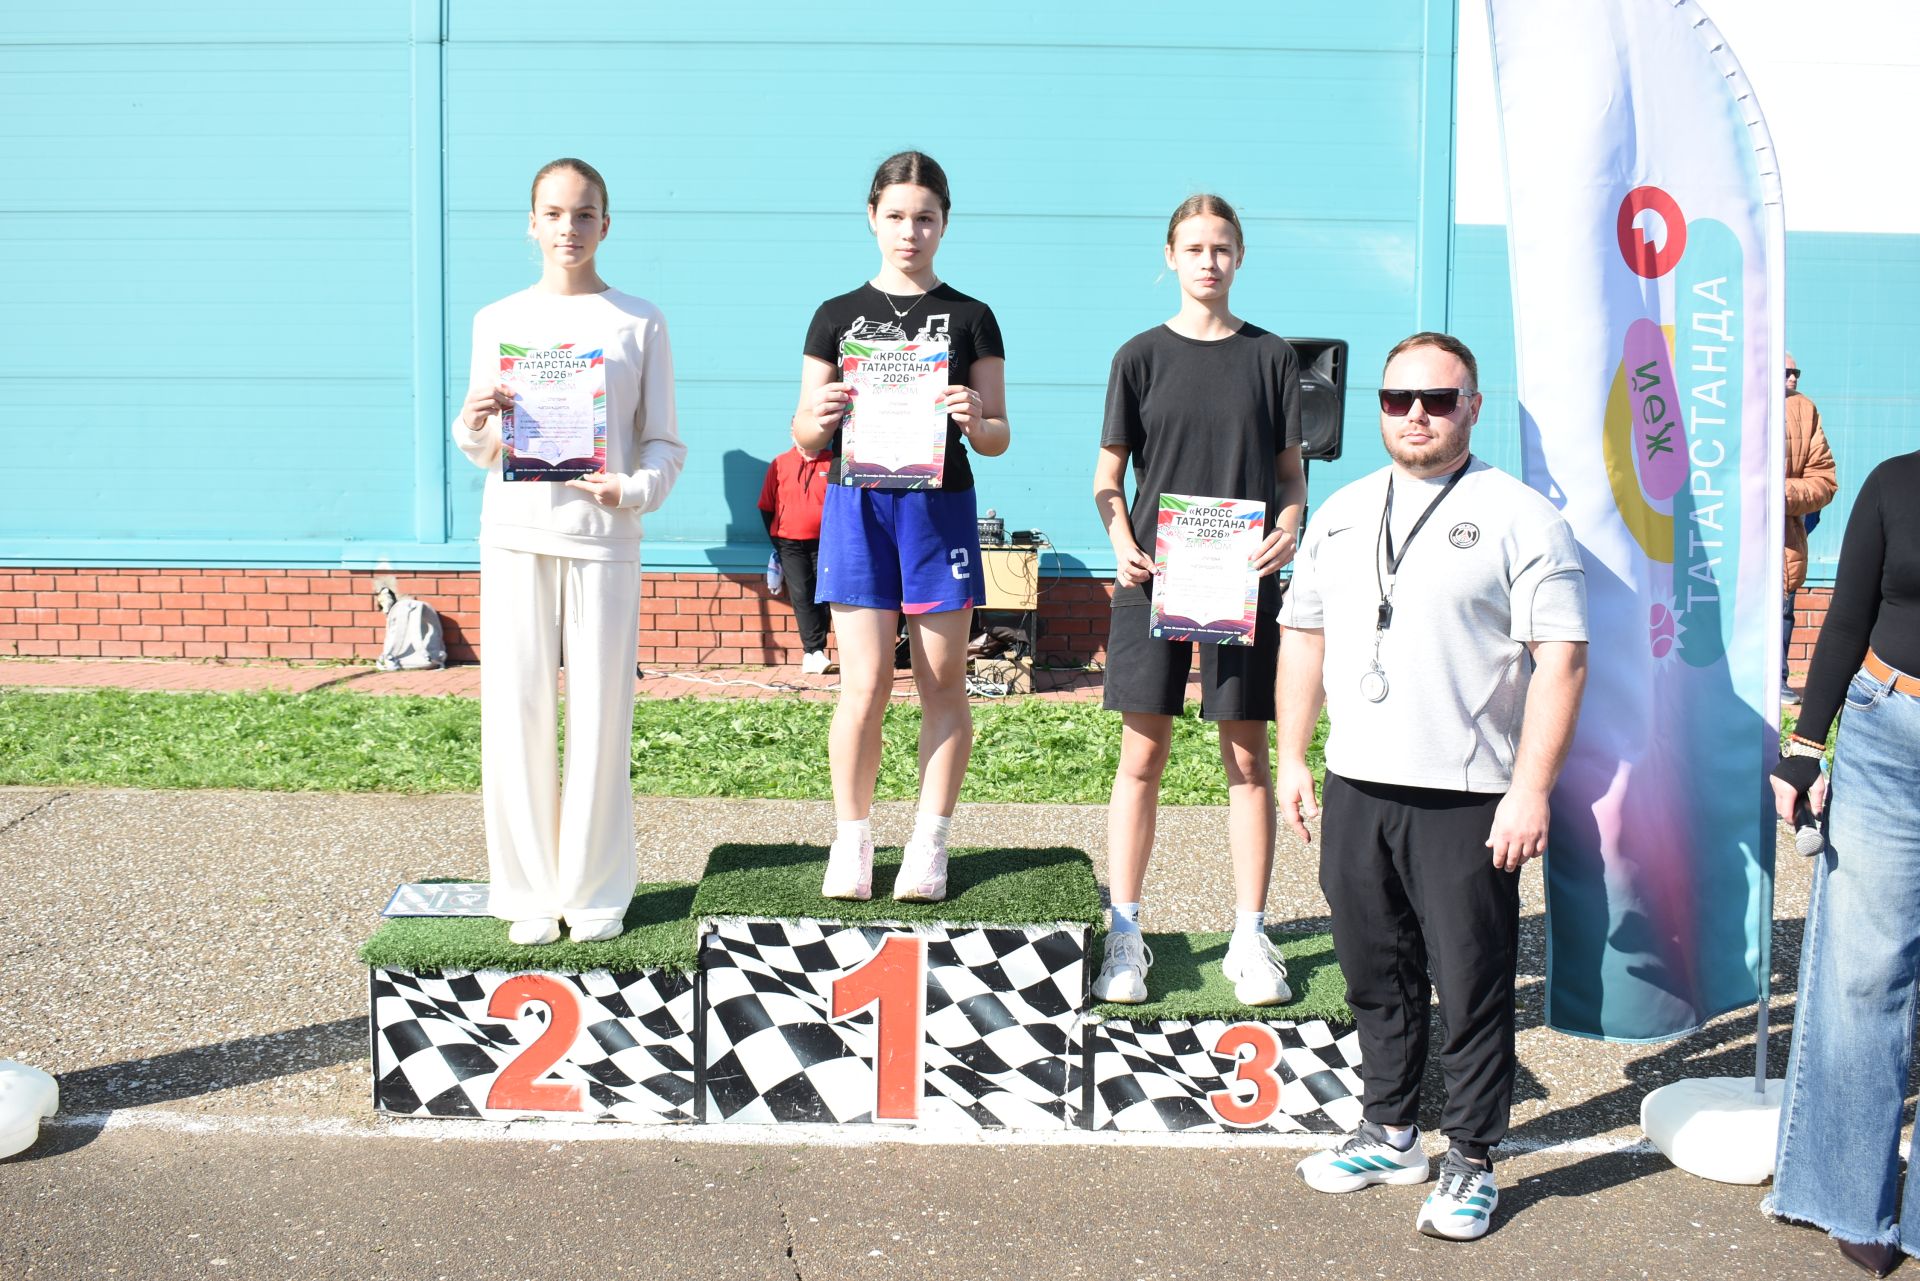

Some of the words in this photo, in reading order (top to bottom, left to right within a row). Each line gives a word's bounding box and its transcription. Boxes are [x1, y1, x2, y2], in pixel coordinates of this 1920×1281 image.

[530, 350, 573, 359] «КРОСС
[873, 352, 917, 362] «КРОСС
[518, 360, 587, 370] ТАТАРСТАНА
[861, 362, 931, 372] ТАТАРСТАНА
[540, 370, 573, 379] 2026»
[882, 373, 916, 383] 2026»
[1685, 275, 1735, 614] ТАТАРСТАНДА
[1189, 507, 1233, 518] «КРОСС
[1175, 516, 1246, 529] ТАТАРСТАНА
[1196, 528, 1230, 539] 2026»
[950, 547, 970, 580] 2
[831, 935, 926, 1121] 1
[484, 973, 585, 1113] 2
[1209, 1023, 1285, 1126] 3
